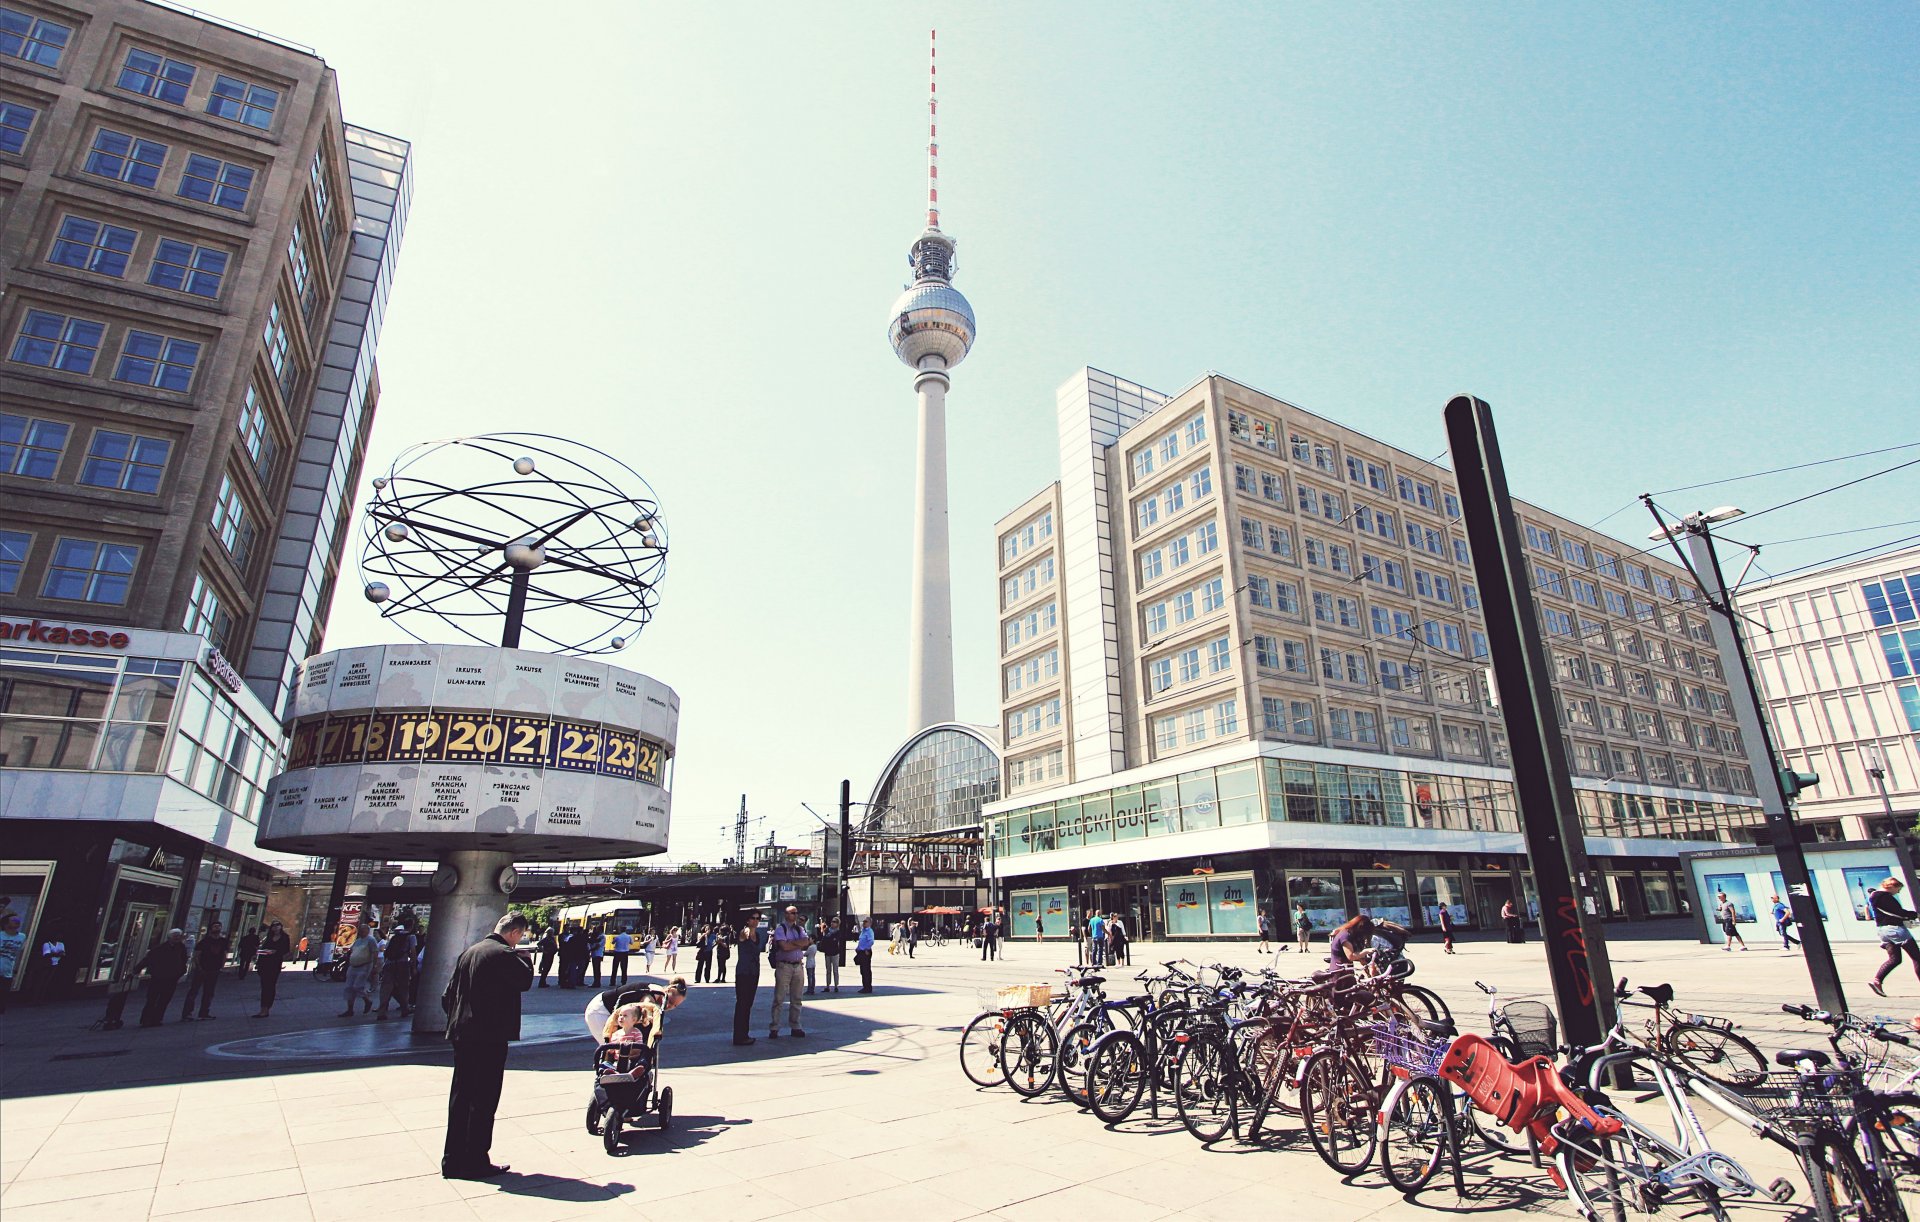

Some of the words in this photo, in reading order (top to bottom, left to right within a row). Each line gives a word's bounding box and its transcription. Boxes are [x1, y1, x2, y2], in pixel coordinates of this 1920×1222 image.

[208, 648, 242, 693] Sparkasse
[314, 724, 344, 754] 17
[352, 721, 386, 752] 18
[400, 721, 441, 750] 19
[448, 721, 502, 753] 20
[510, 725, 550, 755] 21
[561, 731, 602, 762] 22
[606, 738, 636, 768] 23
[638, 746, 658, 776] 24
[849, 850, 980, 872] ALEXANDER
[1022, 899, 1031, 910] dm
[1050, 897, 1060, 908] dm
[1180, 888, 1195, 902] dm
[1224, 886, 1242, 899] dm
